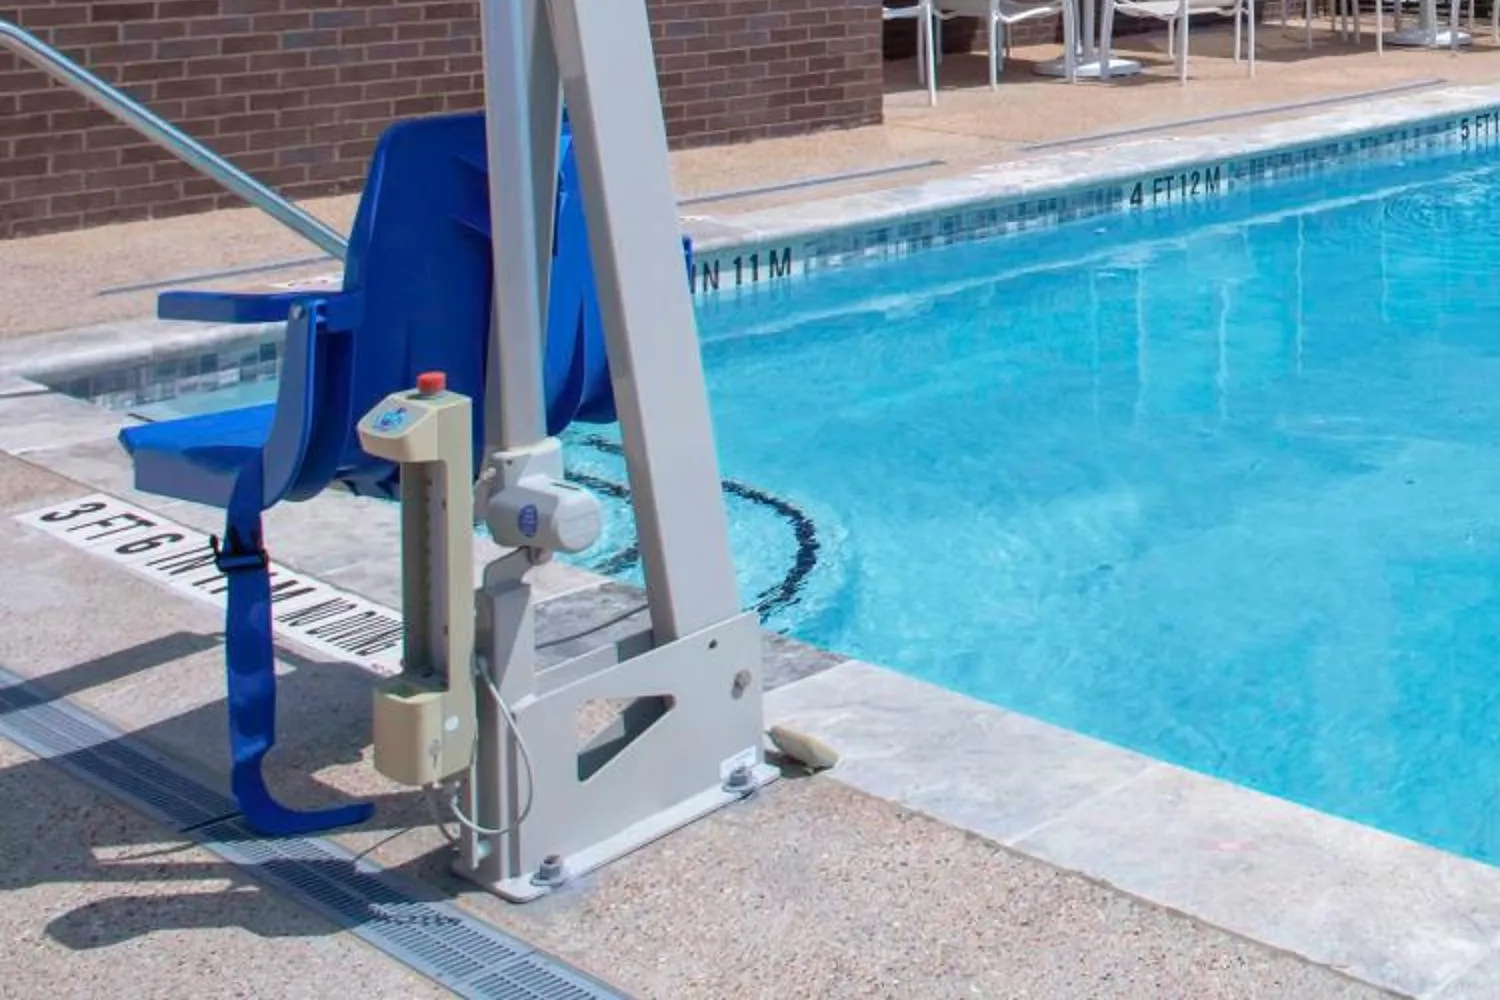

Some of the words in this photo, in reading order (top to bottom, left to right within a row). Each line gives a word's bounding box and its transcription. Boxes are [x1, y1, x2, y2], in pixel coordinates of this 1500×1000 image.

[1460, 117, 1470, 140] 5
[1475, 112, 1490, 137] FT
[1130, 181, 1143, 205] 4
[1153, 174, 1175, 204] FT
[1205, 164, 1221, 194] M
[769, 247, 792, 279] M
[39, 501, 107, 524] 3
[66, 512, 156, 541] FT
[114, 532, 186, 556] 6
